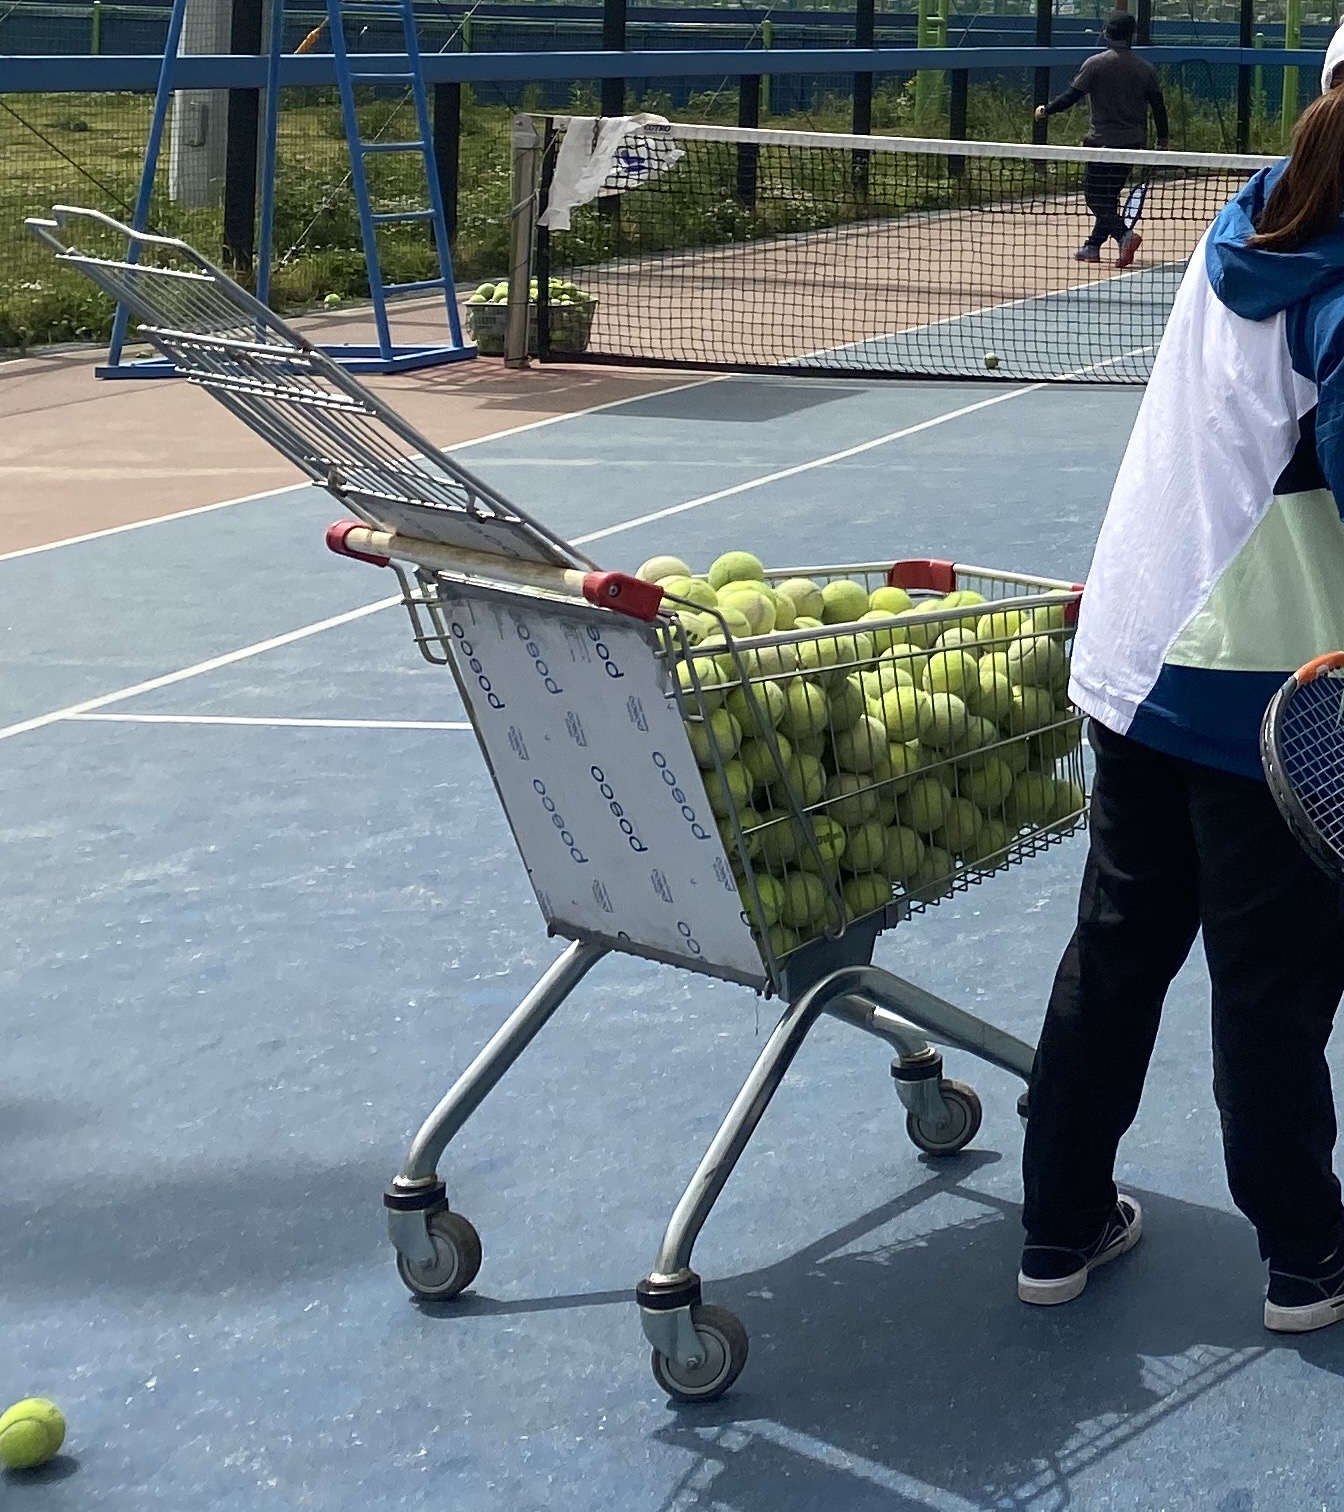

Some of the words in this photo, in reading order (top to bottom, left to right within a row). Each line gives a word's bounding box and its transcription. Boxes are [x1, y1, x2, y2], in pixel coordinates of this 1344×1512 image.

[451, 622, 506, 709] posco
[514, 619, 563, 694] posc
[533, 779, 589, 863] posco
[591, 766, 648, 852] posco
[652, 751, 711, 840] posco
